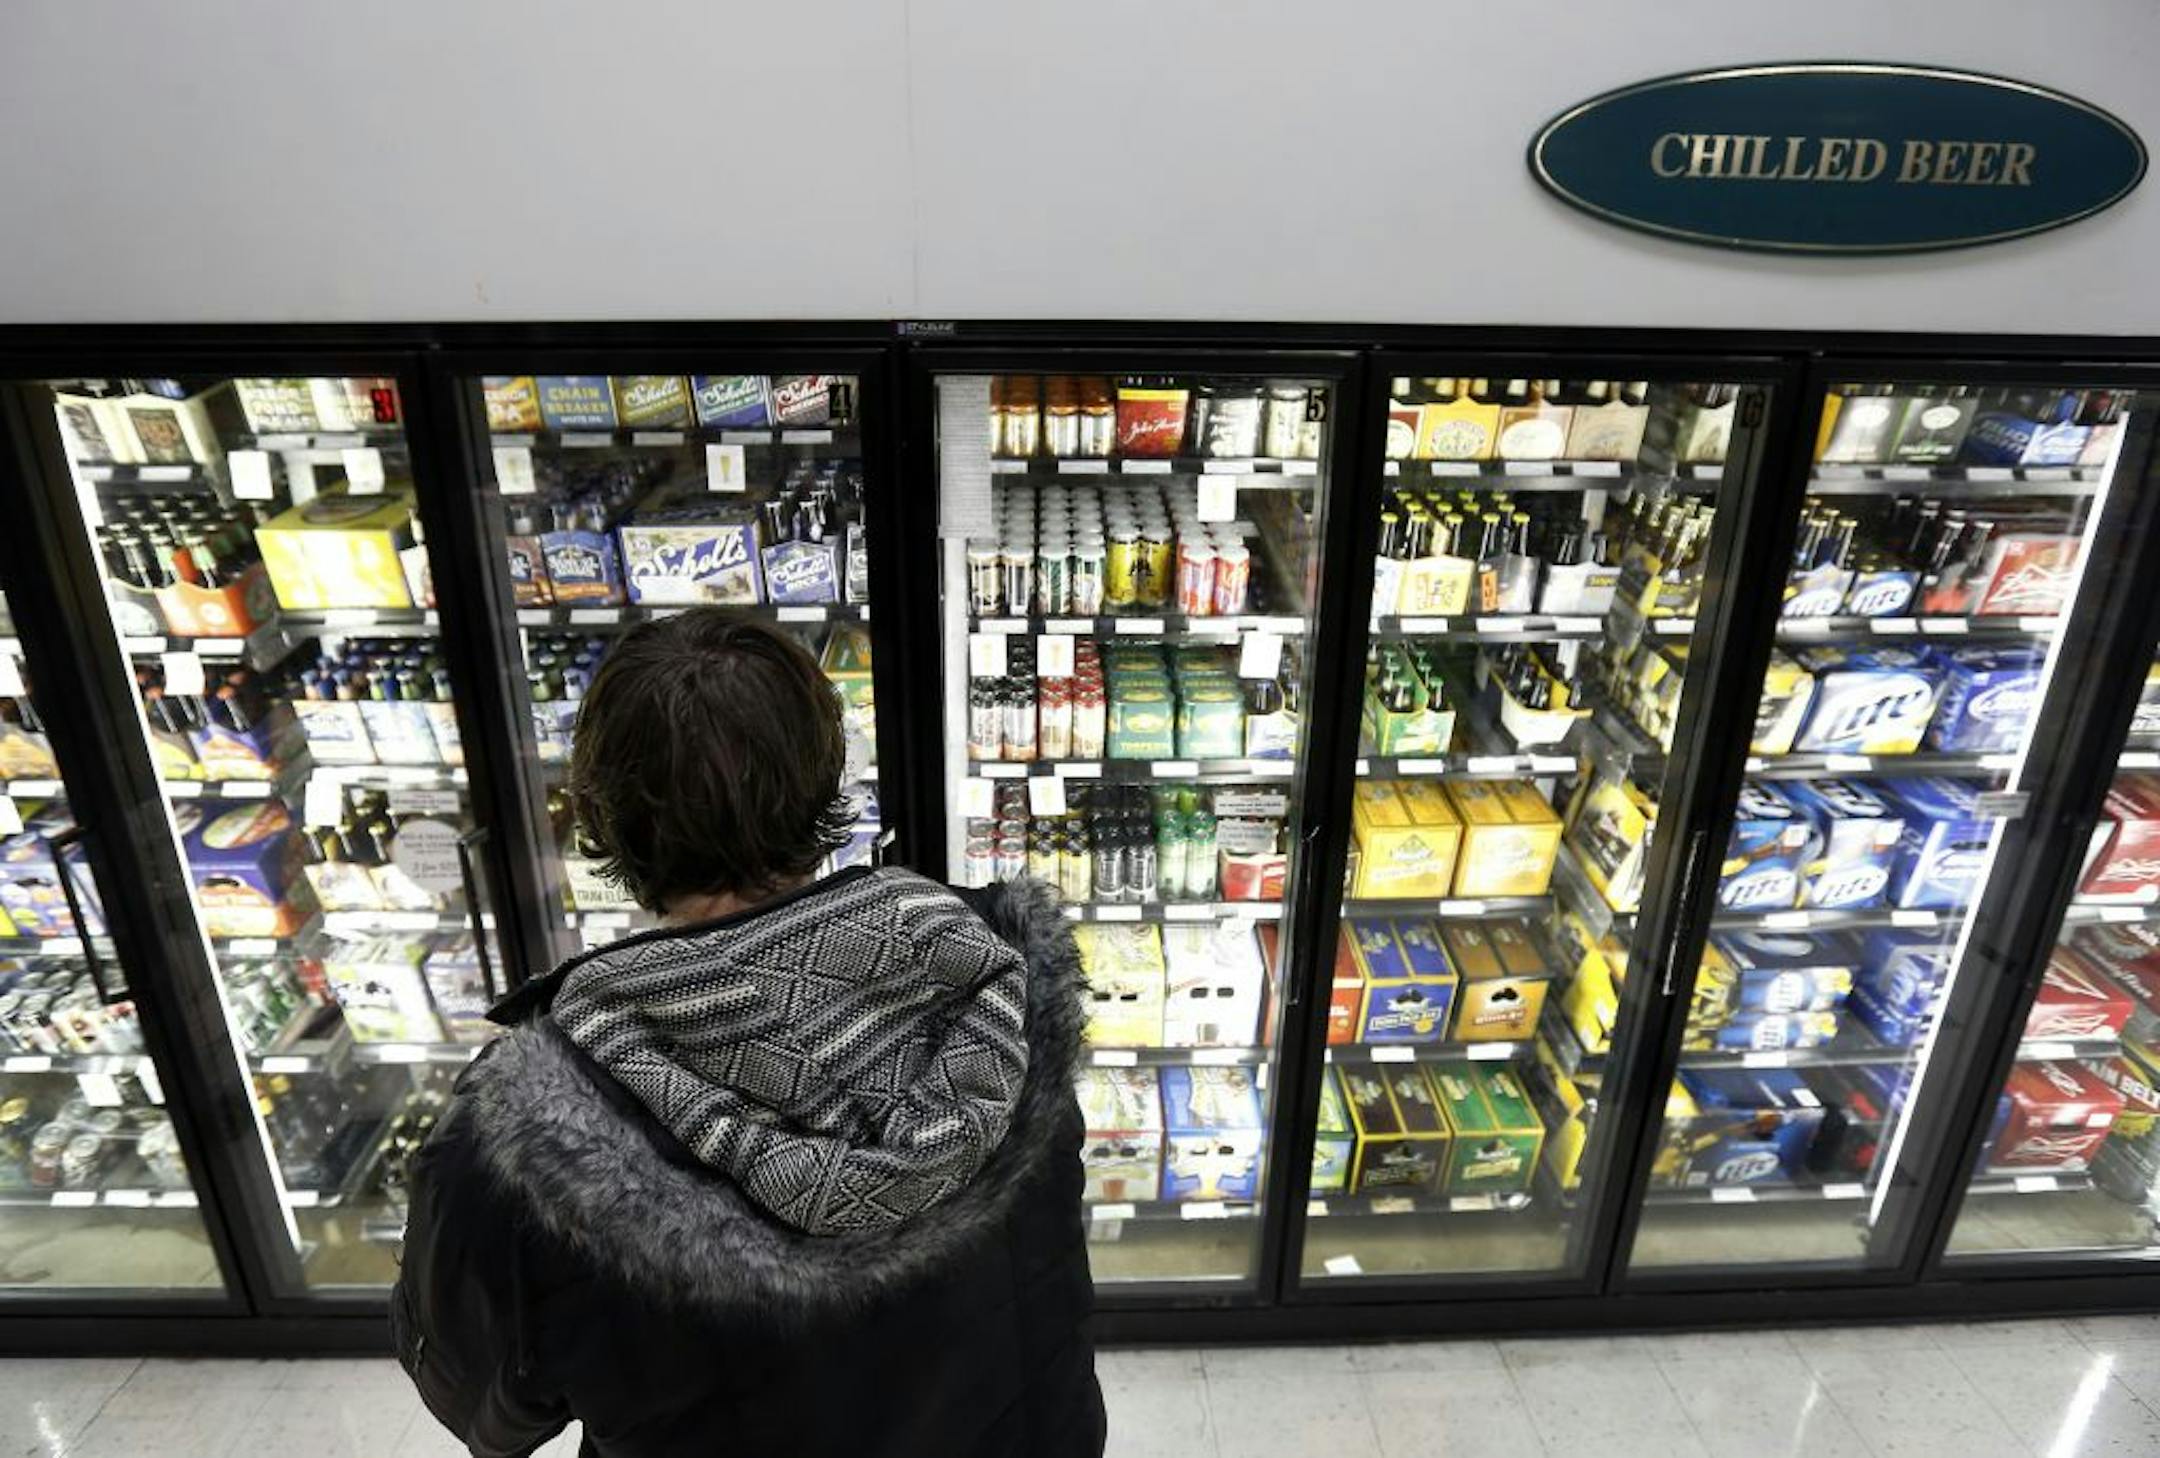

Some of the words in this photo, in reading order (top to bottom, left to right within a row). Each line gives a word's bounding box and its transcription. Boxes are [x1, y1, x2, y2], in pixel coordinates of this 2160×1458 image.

[1649, 133, 1888, 182] CHILLED
[1895, 141, 2038, 187] BEER
[1308, 388, 1327, 421] 5
